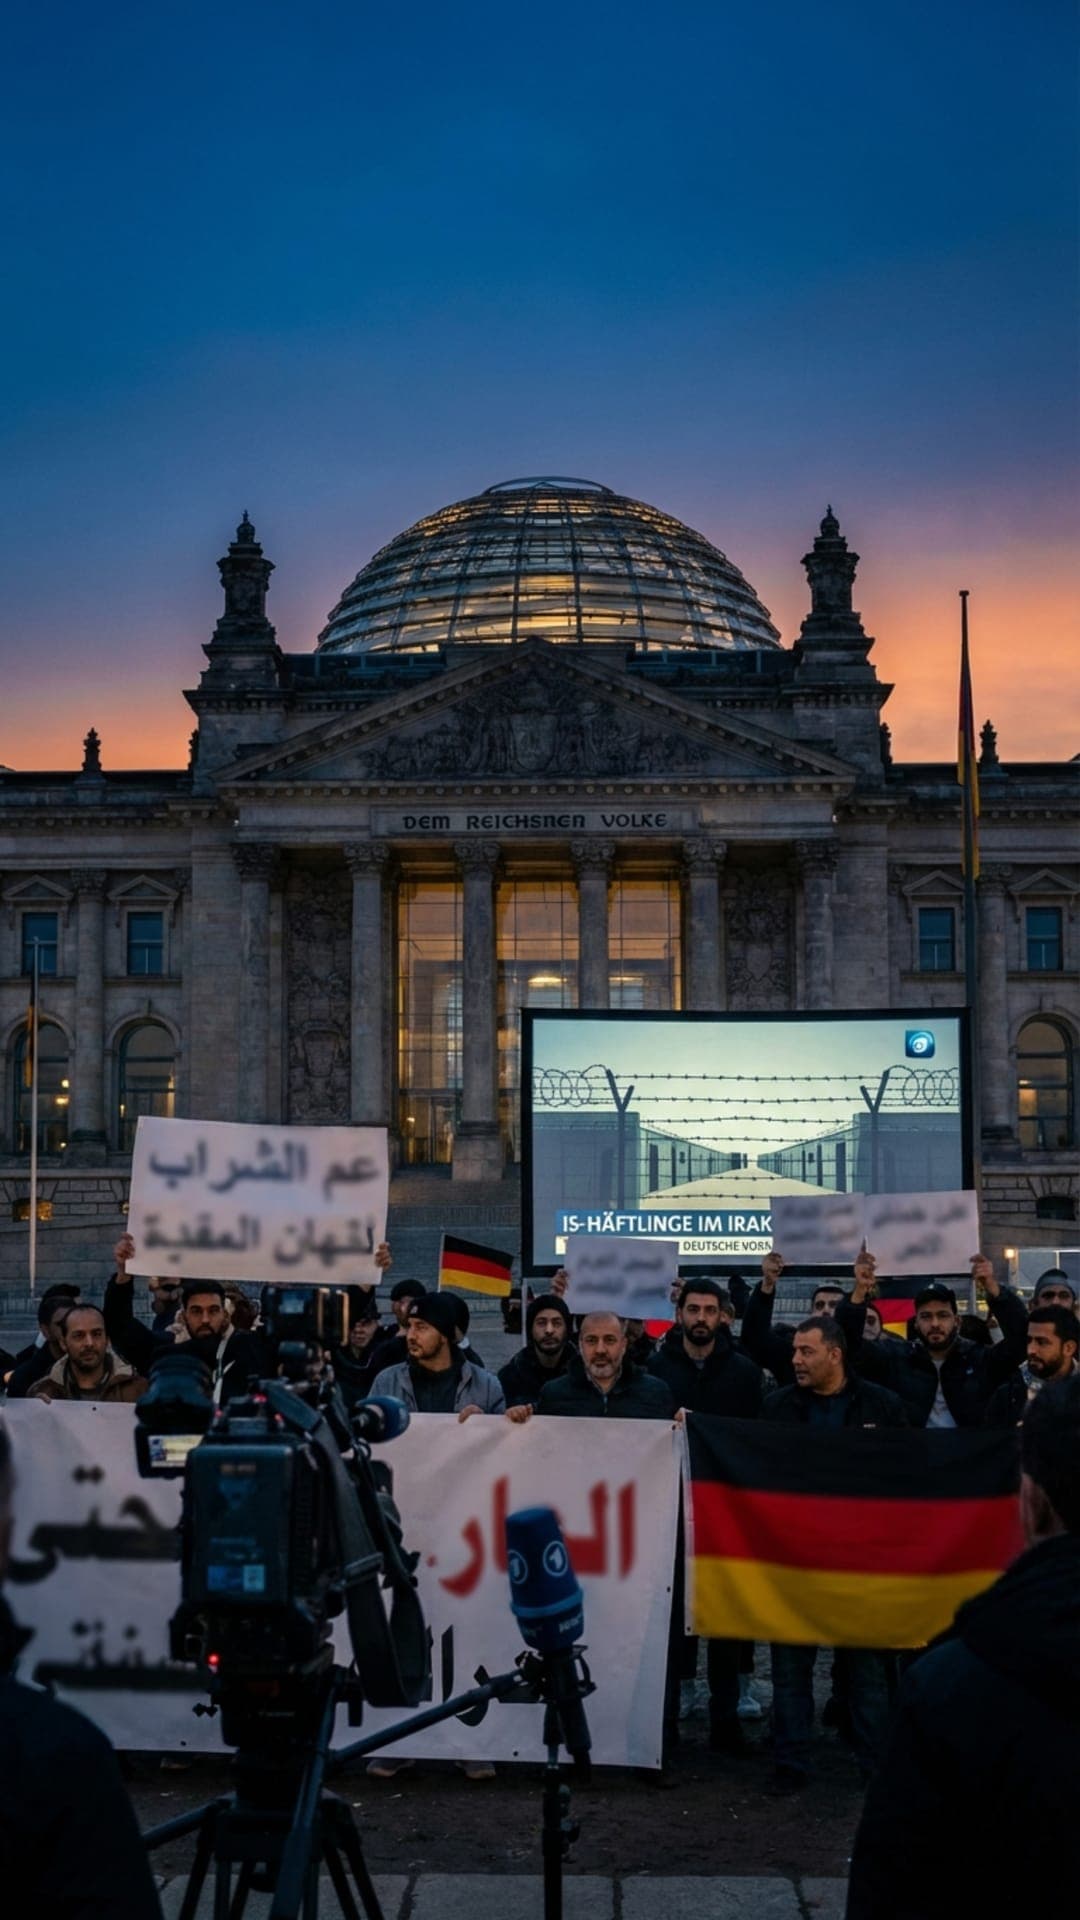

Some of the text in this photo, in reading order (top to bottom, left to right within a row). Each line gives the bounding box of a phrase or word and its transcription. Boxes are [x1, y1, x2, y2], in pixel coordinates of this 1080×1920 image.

[402, 815, 450, 829] DEM
[601, 813, 667, 828] VOLKE
[563, 1211, 772, 1232] IS-HÄFTLINGE IM IRAK
[683, 1241, 739, 1251] DEUTSCHE
